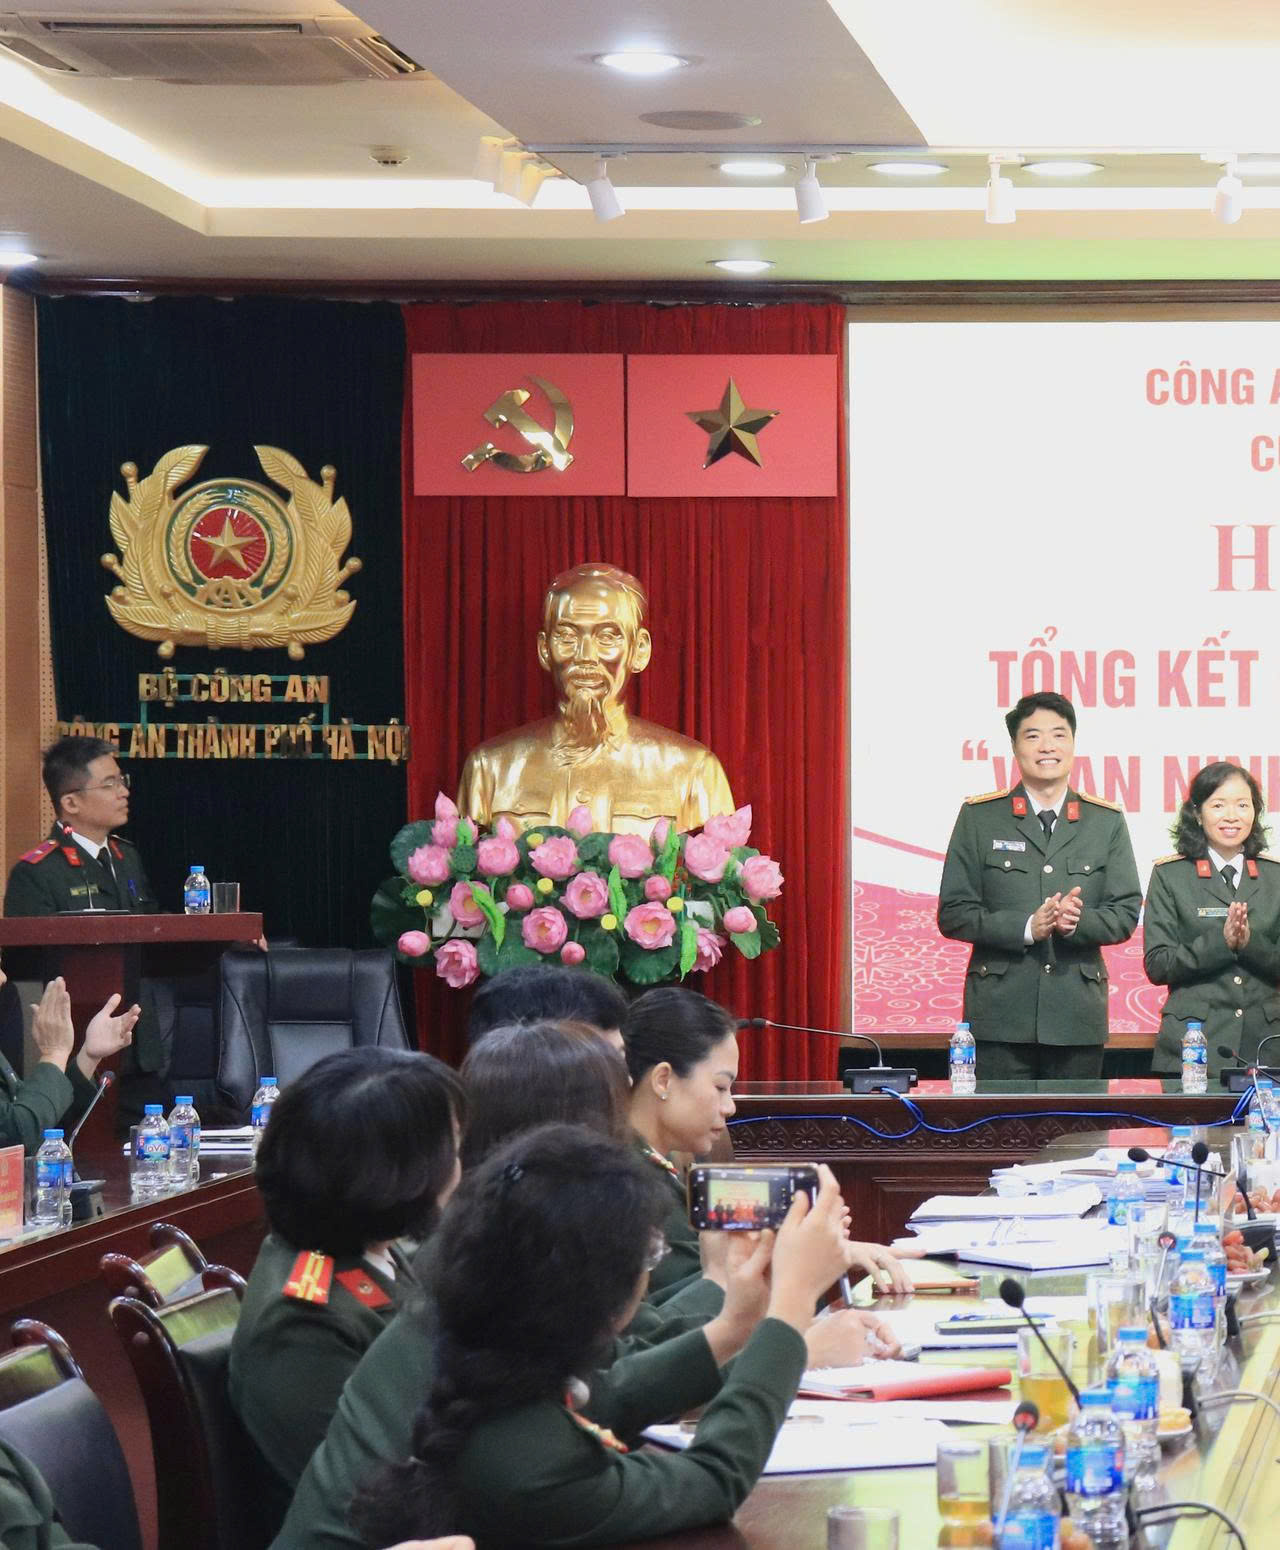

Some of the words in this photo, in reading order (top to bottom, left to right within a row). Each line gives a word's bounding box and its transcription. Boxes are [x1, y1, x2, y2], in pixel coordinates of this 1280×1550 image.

[1147, 360, 1253, 404] CÔNG
[138, 666, 179, 707] BỘ
[190, 666, 272, 703] CÔNG
[284, 674, 330, 703] AN
[988, 626, 1137, 708] TỔNG
[1158, 630, 1259, 708] KẾT
[128, 722, 166, 759] AN
[174, 715, 256, 760] THÀNH
[264, 712, 314, 760] PHỐ
[322, 717, 355, 760] HÀ
[367, 716, 411, 766] NỘI
